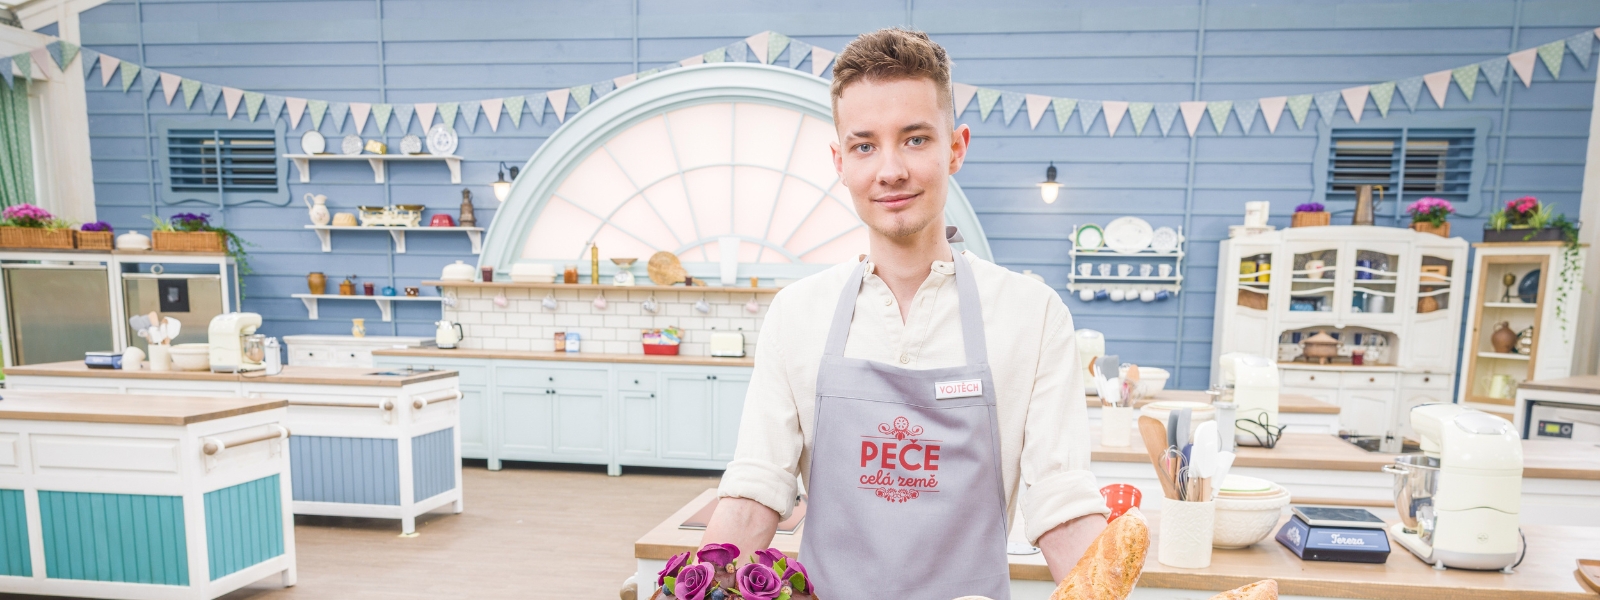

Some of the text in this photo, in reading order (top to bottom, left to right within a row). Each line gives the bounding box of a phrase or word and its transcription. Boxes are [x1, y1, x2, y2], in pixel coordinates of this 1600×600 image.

[939, 382, 979, 394] VOJTĚCH
[860, 439, 941, 471] PEČE
[859, 470, 938, 488] celá země
[1331, 533, 1364, 545] Tereza
